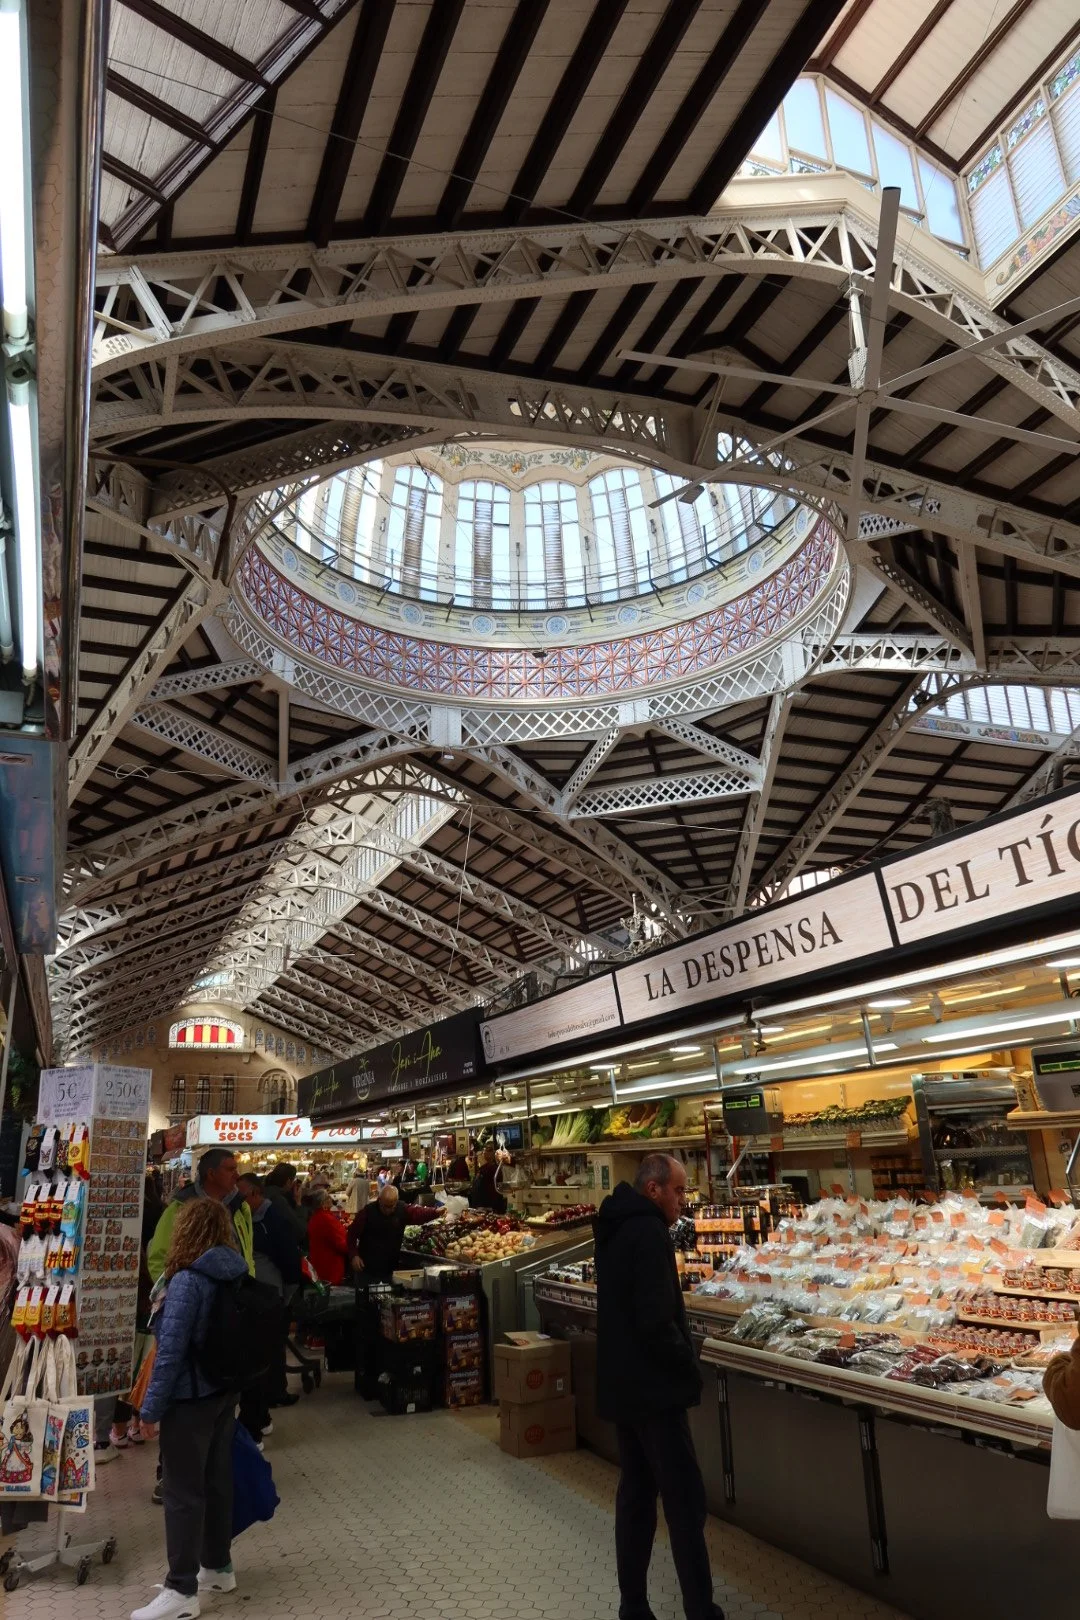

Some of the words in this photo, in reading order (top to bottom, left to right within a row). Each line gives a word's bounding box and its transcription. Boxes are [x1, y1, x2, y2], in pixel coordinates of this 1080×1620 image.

[644, 967, 676, 1001] LA
[682, 911, 843, 989] DESPENSA
[890, 859, 990, 924] DEL
[57, 1082, 78, 1101] 5€
[214, 1117, 258, 1131] fruits
[218, 1131, 253, 1141] secs
